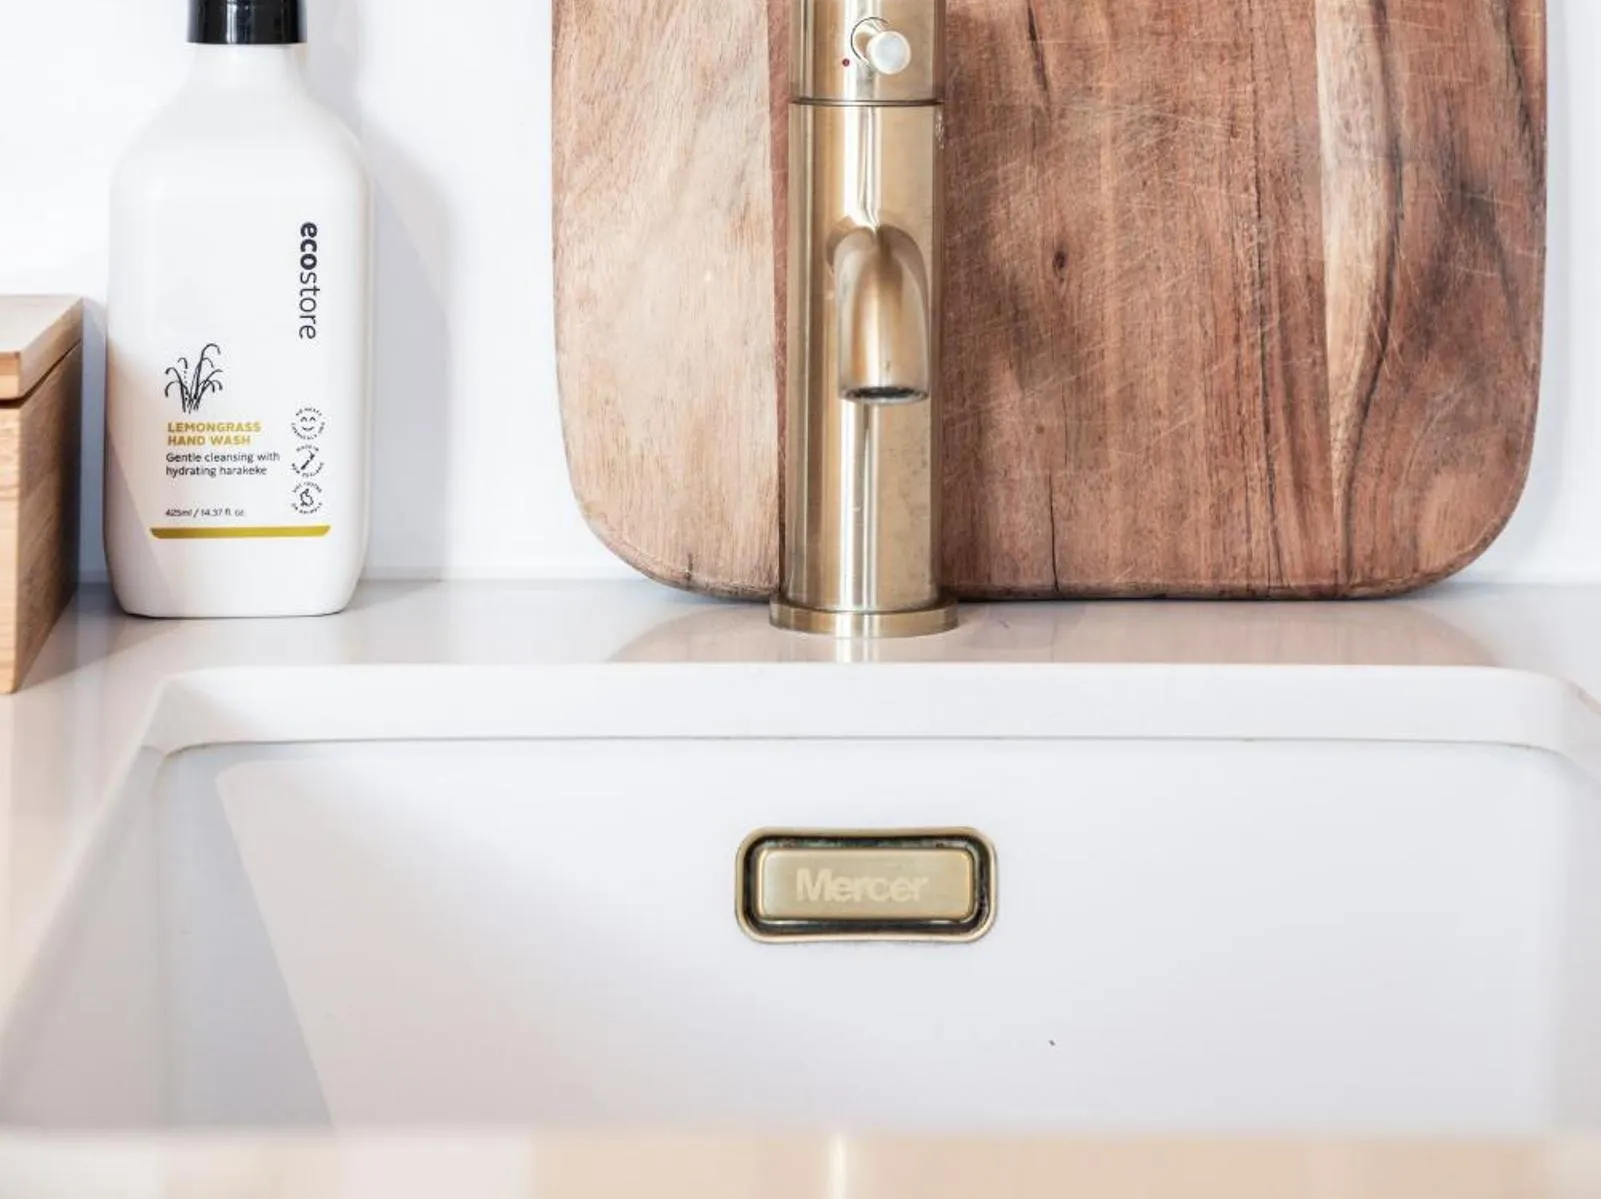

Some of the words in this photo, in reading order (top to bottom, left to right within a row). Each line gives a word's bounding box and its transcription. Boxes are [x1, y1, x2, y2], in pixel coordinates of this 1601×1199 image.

[299, 222, 320, 339] ecostore
[167, 422, 261, 433] LEMONGRASS
[167, 435, 206, 446] HAND
[211, 435, 251, 446] WASH
[165, 453, 202, 463] Gentle
[204, 452, 254, 465] cleansing
[257, 452, 281, 462] with
[165, 466, 217, 478] hydrating
[219, 466, 268, 476] harakeke
[796, 867, 928, 903] Mercer
